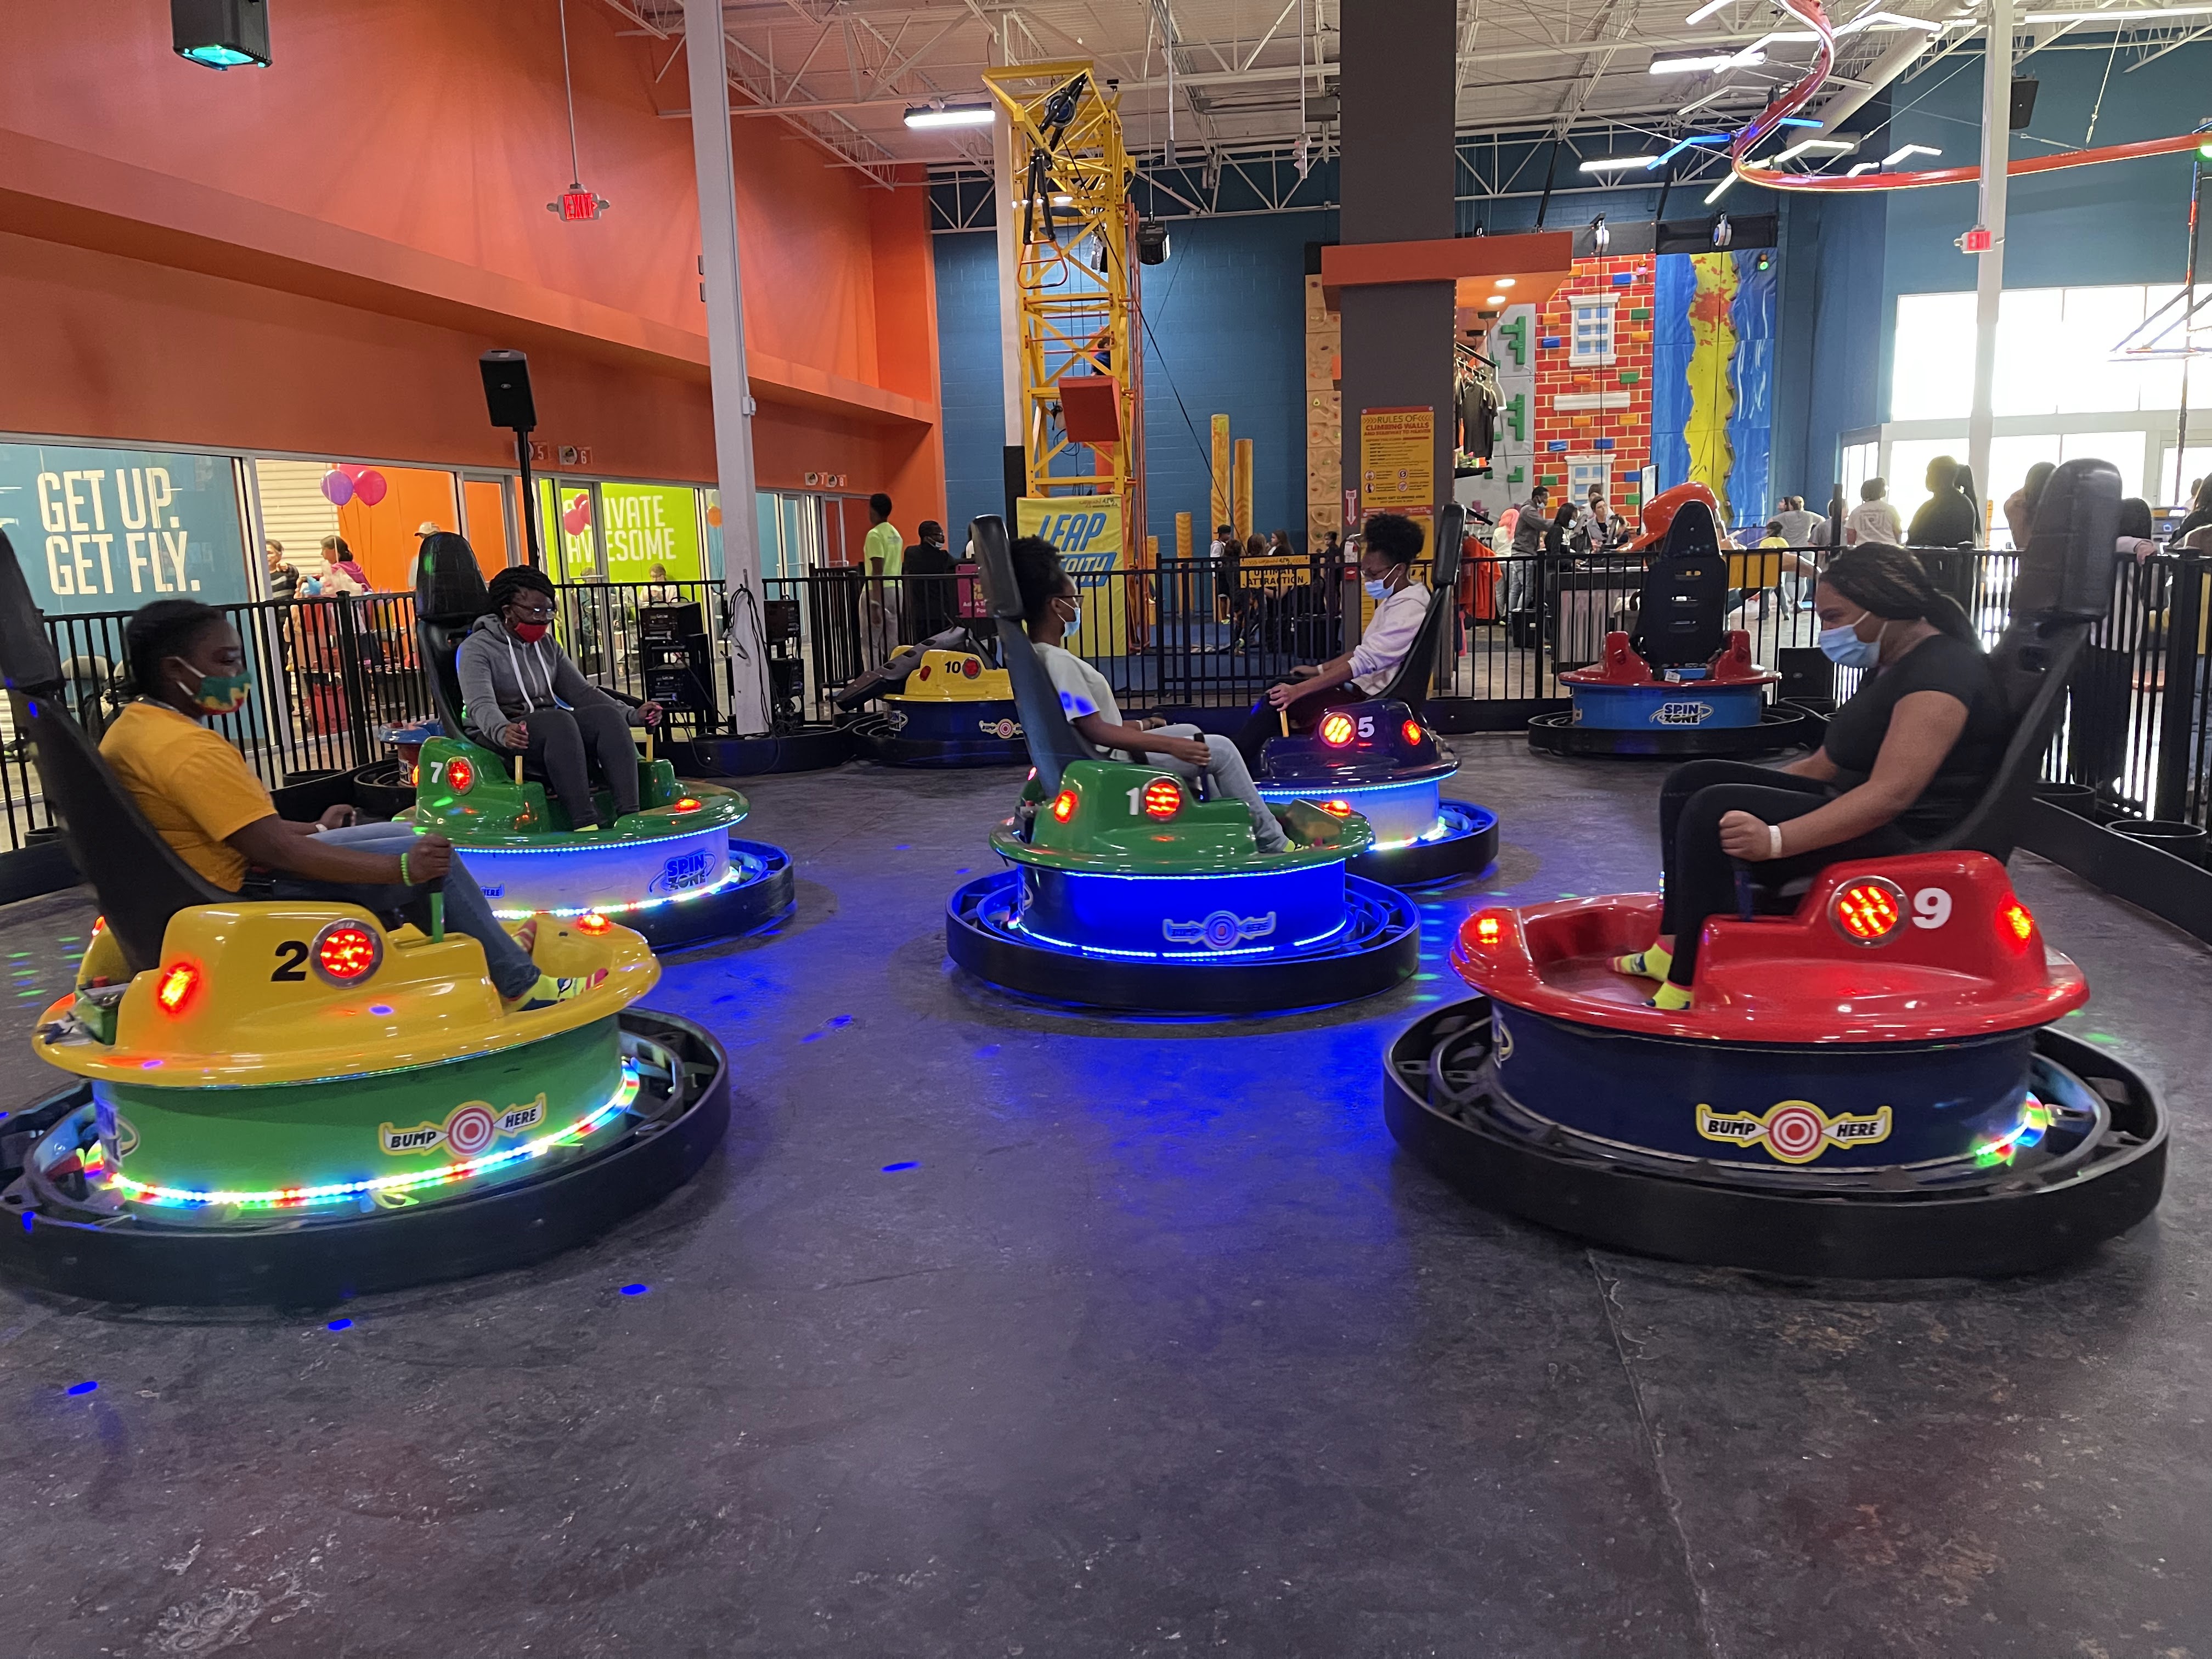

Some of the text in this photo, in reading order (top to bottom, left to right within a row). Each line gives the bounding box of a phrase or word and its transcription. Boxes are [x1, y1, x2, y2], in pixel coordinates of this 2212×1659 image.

[564, 194, 593, 219] EXIT
[1378, 415, 1403, 424] RULES
[538, 445, 544, 460] 5
[581, 450, 587, 464] 6
[820, 475, 824, 484] 7
[839, 477, 844, 487] 8
[38, 468, 179, 532] GET UP.
[563, 495, 665, 530] IVATE
[46, 531, 200, 594] GET FLY.
[1061, 556, 1108, 583] AITH
[1248, 576, 1303, 585] ATRATION
[945, 661, 961, 674] 10
[1664, 704, 1699, 714] SPIN
[1664, 714, 1698, 723] ZONE
[1358, 716, 1374, 737] 5
[431, 761, 443, 783] 7
[1126, 787, 1139, 815] 1
[667, 854, 704, 877] SPIN
[668, 872, 706, 889] ZONE
[1912, 888, 1952, 929] 9
[270, 940, 309, 981] 2
[391, 1108, 537, 1148] BUMP HERE
[1708, 1120, 1877, 1137] BUMP HERE
